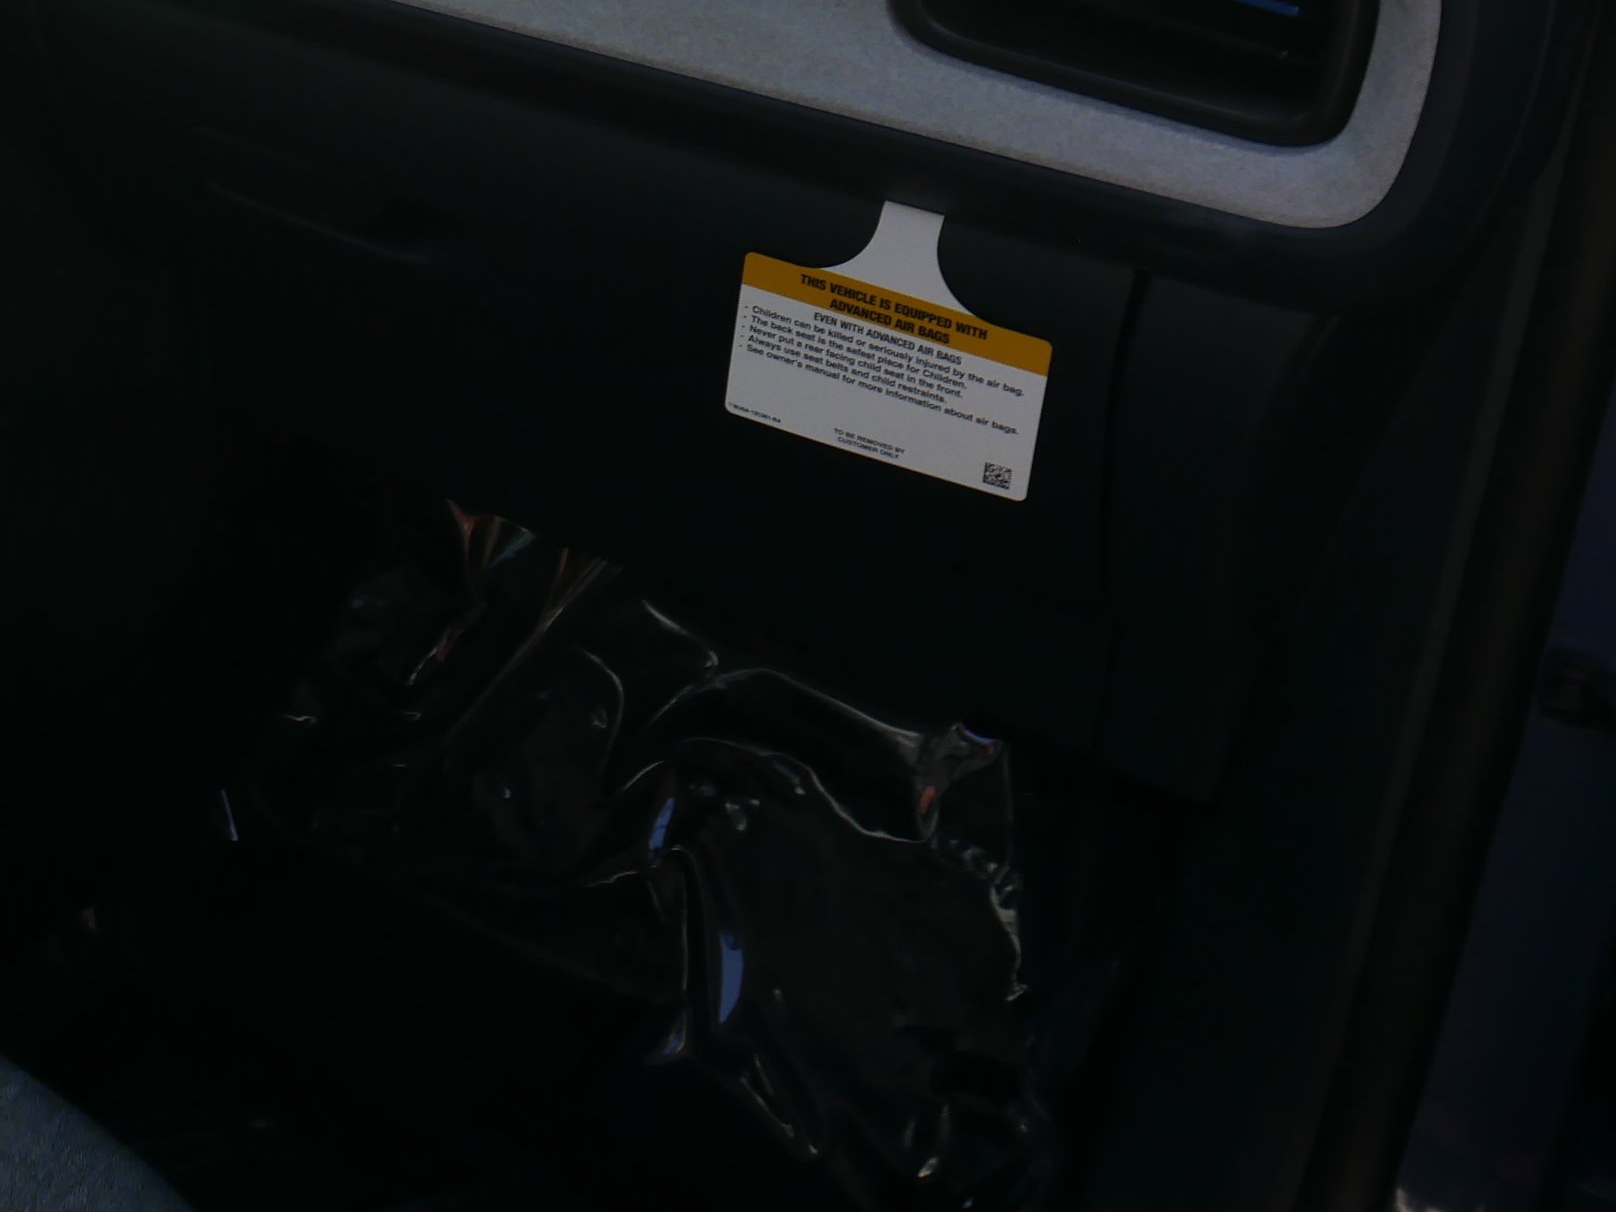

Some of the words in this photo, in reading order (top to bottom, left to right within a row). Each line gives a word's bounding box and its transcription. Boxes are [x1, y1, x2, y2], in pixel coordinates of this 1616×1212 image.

[800, 274, 826, 291] THIS
[829, 283, 876, 306] VEHICLE
[880, 298, 890, 310] IS
[895, 304, 952, 329] EQUIPPED
[955, 322, 987, 340] WITH
[830, 299, 891, 325] ADVANCED
[895, 319, 914, 333] AIR
[918, 326, 949, 344] BAGS
[748, 335, 781, 352] Always
[785, 348, 800, 357] use
[803, 353, 822, 364] seat
[826, 359, 848, 372] belts
[851, 367, 869, 379] and
[872, 374, 895, 387] child
[750, 326, 776, 339] Never
[779, 335, 794, 346] put
[805, 344, 823, 354] rear
[826, 349, 855, 365] facing
[858, 359, 881, 372] child
[884, 368, 904, 379] seat
[907, 375, 916, 383] in
[919, 378, 934, 389] the
[751, 315, 768, 327] The
[771, 322, 792, 334] back
[795, 330, 815, 341] seat
[829, 340, 843, 350] the
[846, 346, 874, 360] safest
[877, 355, 903, 370] place
[906, 364, 919, 374] for
[752, 305, 791, 324] Children
[794, 320, 811, 329] can
[814, 324, 826, 334] be
[828, 329, 853, 343] killed
[856, 339, 866, 347] or
[869, 342, 913, 363] seriously
[916, 357, 949, 374] injured
[952, 368, 965, 380] by
[968, 373, 984, 383] the
[987, 379, 1000, 388] air
[814, 312, 836, 325] EVEN
[841, 321, 863, 334] WITH
[867, 329, 914, 350] ADVANCED
[918, 345, 933, 356] AIR
[937, 351, 962, 365] BAGS
[747, 344, 764, 355] See
[766, 351, 802, 368] owner's
[805, 363, 840, 379] manual
[843, 374, 855, 384] for
[858, 381, 882, 393] more
[885, 388, 942, 412] information
[944, 406, 973, 421] about
[976, 416, 988, 426] air
